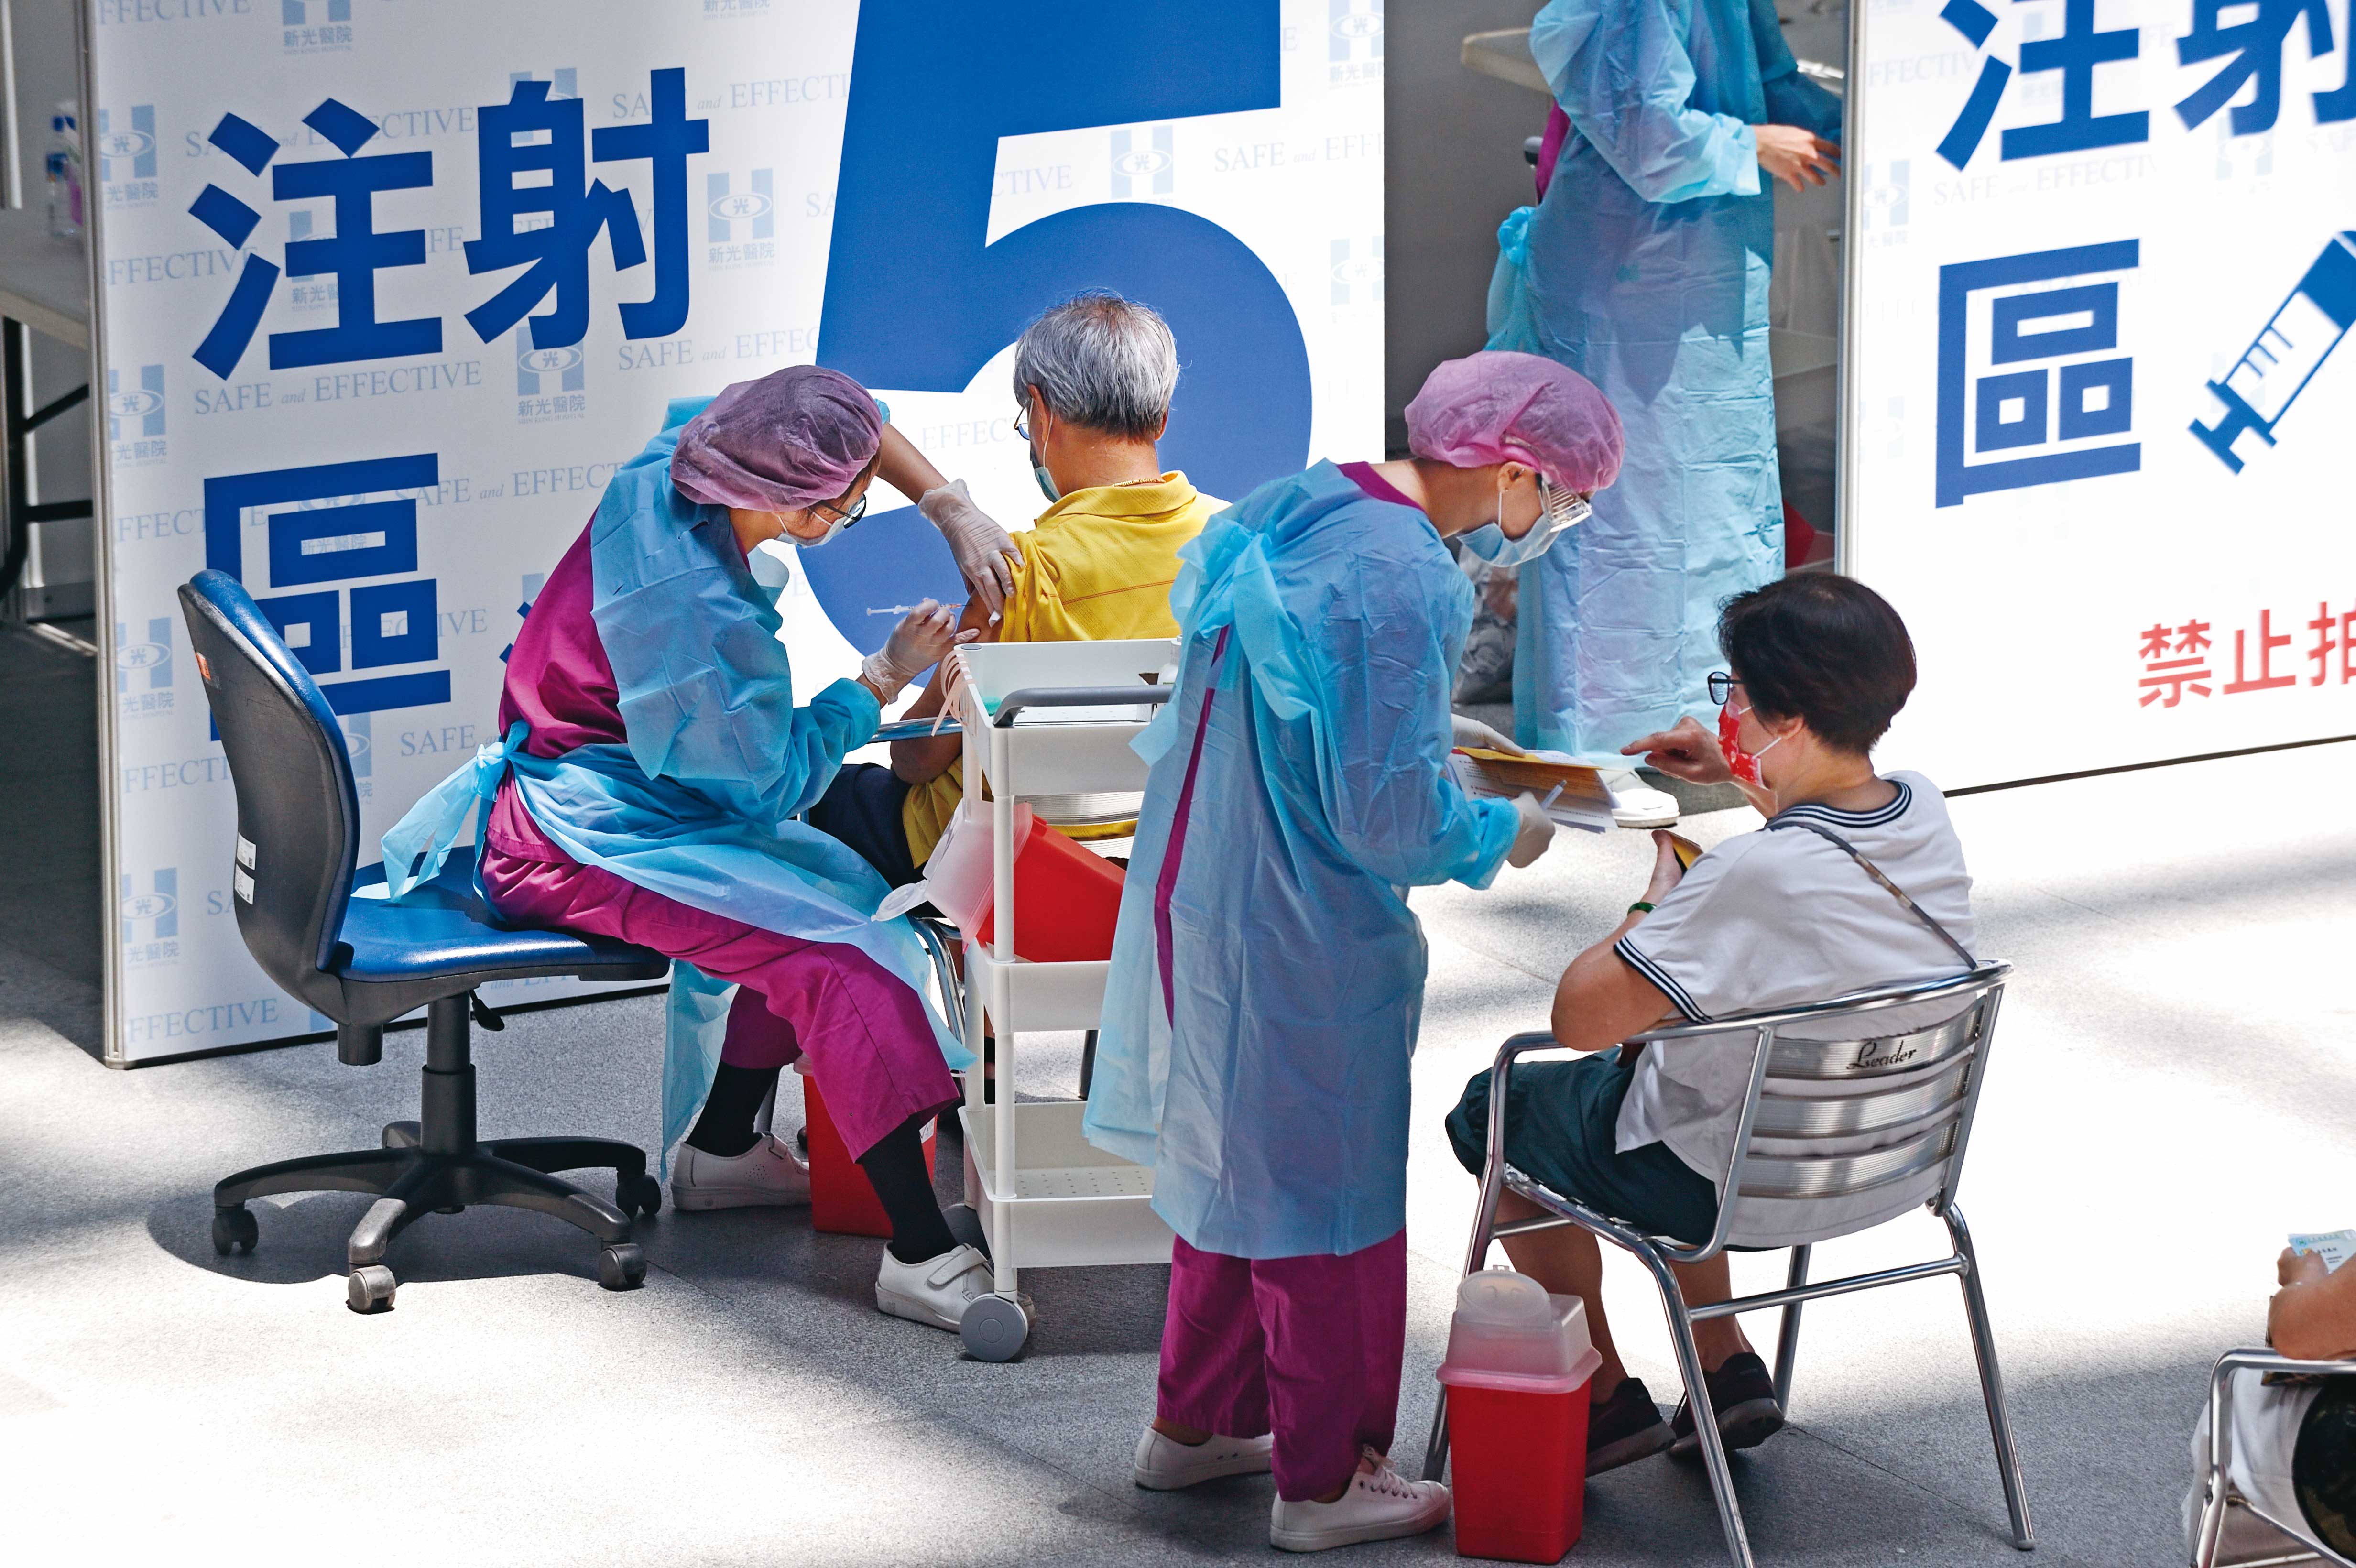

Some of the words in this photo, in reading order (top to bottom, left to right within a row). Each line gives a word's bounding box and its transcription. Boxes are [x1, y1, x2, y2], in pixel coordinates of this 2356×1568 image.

[99, 0, 251, 24] FFECTIVE
[697, 96, 722, 110] and
[730, 73, 851, 109] EFFECTI
[1214, 142, 1285, 173] SAFE
[1293, 149, 1317, 163] and
[107, 182, 159, 204] 光醫院
[1933, 174, 2000, 206] SAFE
[188, 67, 709, 381] 注射
[708, 242, 774, 264] 新光醫院
[292, 283, 339, 304] 新光醫
[618, 340, 693, 370] SAFE
[702, 346, 726, 361] and
[735, 326, 820, 359] EFFEC
[796, 0, 1313, 691] 5
[195, 383, 273, 415] SAFE
[281, 389, 306, 404] and
[314, 361, 482, 403] EFFECTIVE
[1935, 238, 2141, 509] 區
[518, 394, 586, 417] 新光醫院
[116, 440, 167, 460] 光醫院
[480, 484, 505, 500] and
[512, 462, 624, 497] EFFECT
[204, 453, 451, 741] 區
[122, 692, 175, 713] 光醫院
[401, 725, 476, 757] SAFE
[123, 757, 231, 794] FFECTI
[128, 941, 180, 963] 光醫院
[125, 998, 279, 1044] FFECTIVE
[1846, 1041, 1917, 1070] Leader
